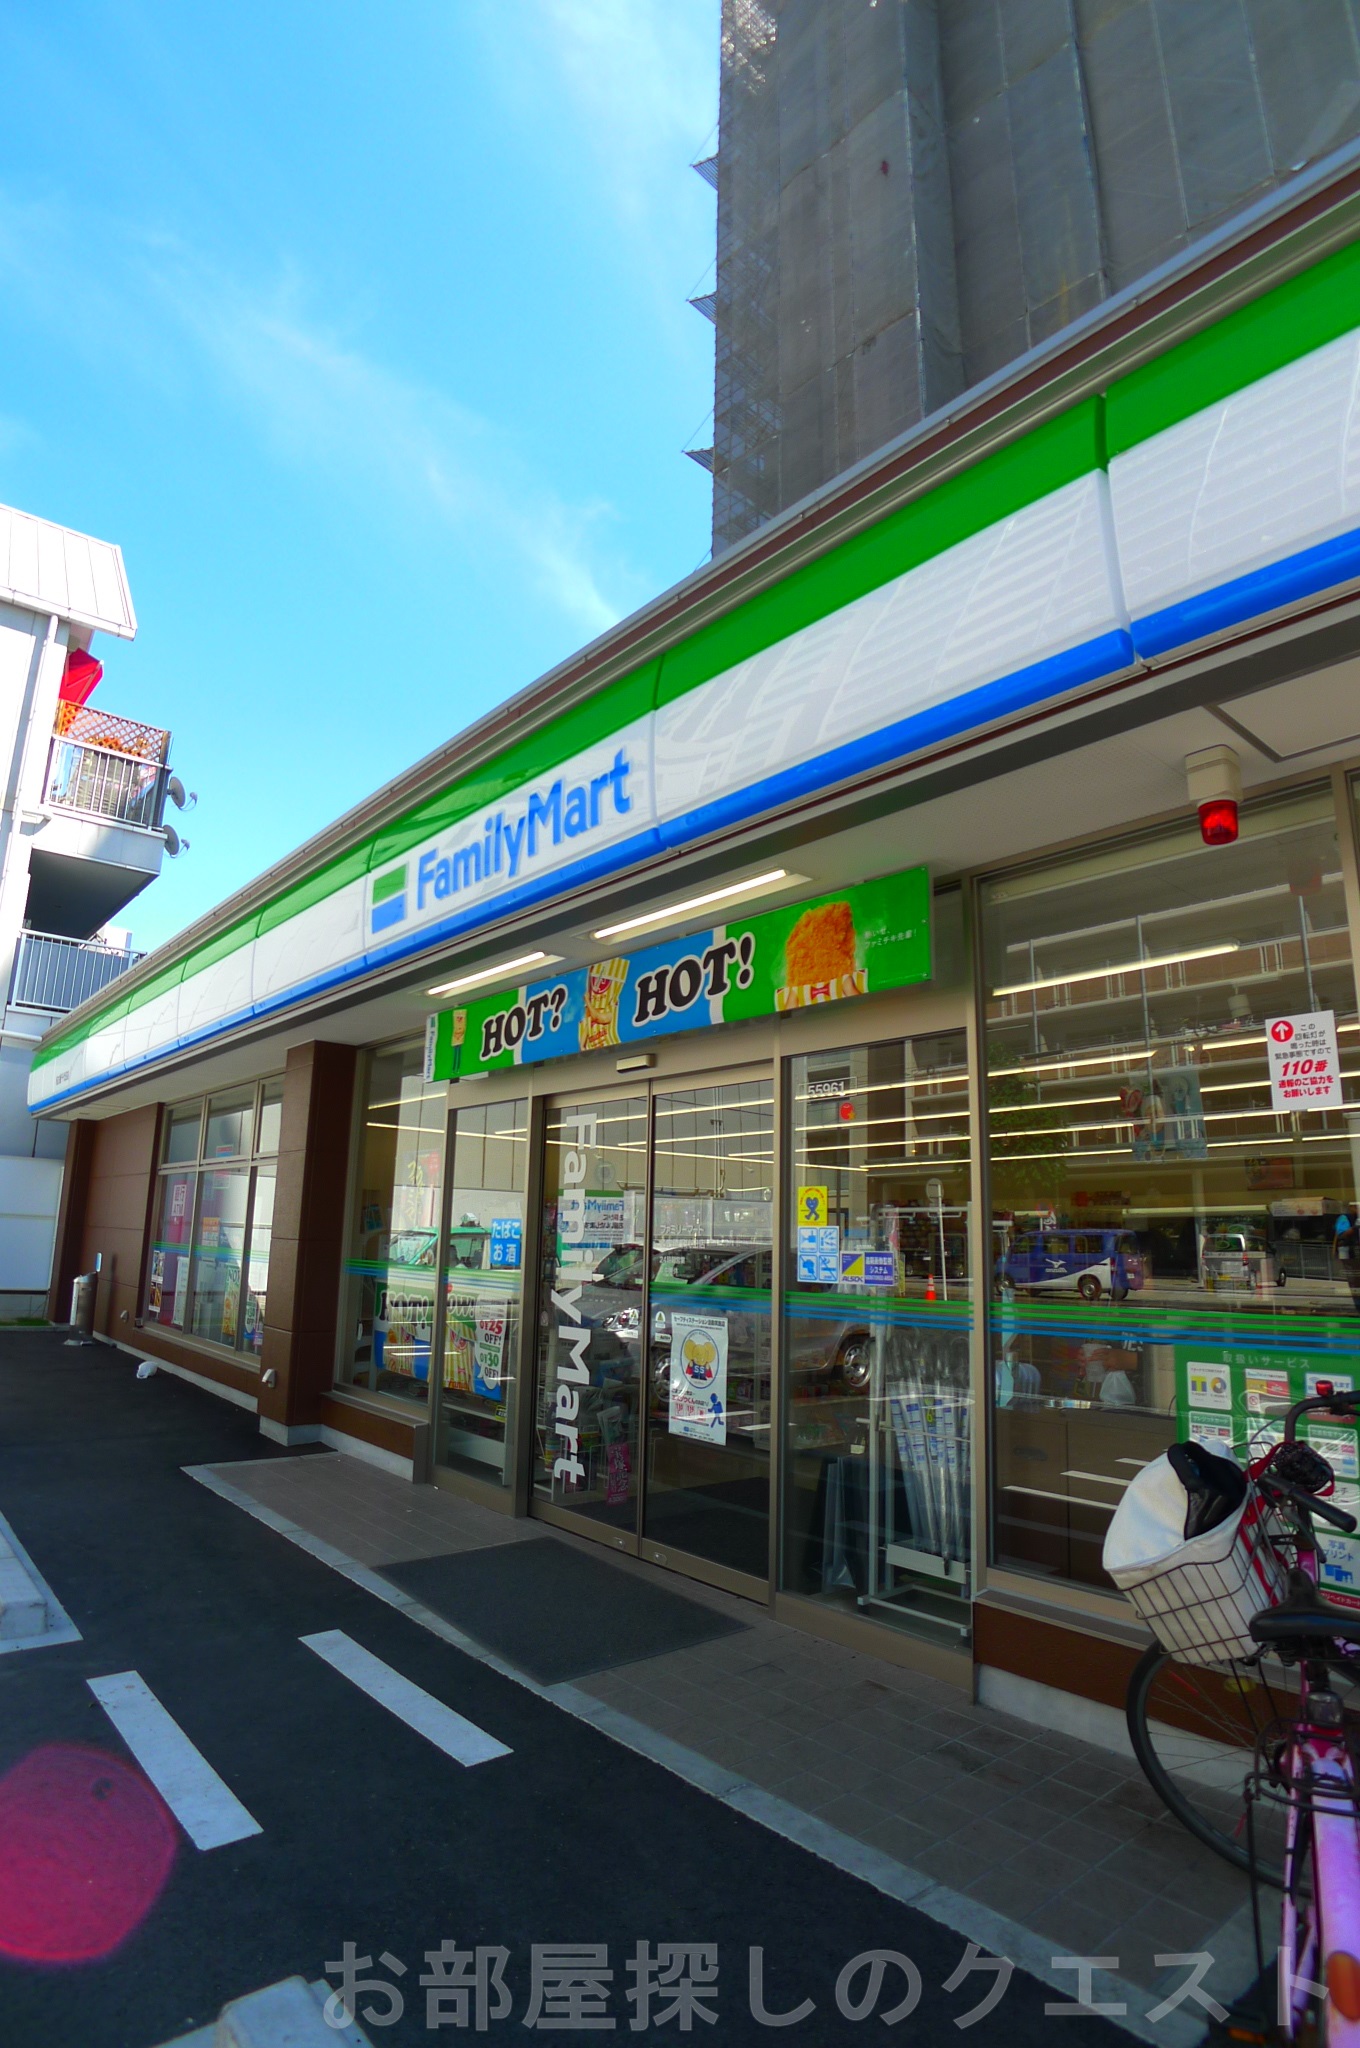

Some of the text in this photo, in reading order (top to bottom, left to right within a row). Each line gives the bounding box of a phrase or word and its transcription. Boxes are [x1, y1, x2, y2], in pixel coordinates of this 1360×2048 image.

[416, 747, 633, 911] FamilyMart
[481, 934, 755, 1059] HOT? HOT!
[1294, 1030, 1326, 1041] 回転灯が
[1300, 1023, 1316, 1031] この
[1282, 1059, 1328, 1077] 110番
[808, 1081, 845, 1097] 55961
[1278, 1075, 1334, 1089] 通報のご協力を
[1283, 1086, 1331, 1098] お願いします
[491, 1221, 520, 1239] たばこ
[493, 1243, 517, 1263] お酒
[551, 1113, 597, 1484] FamilyMart
